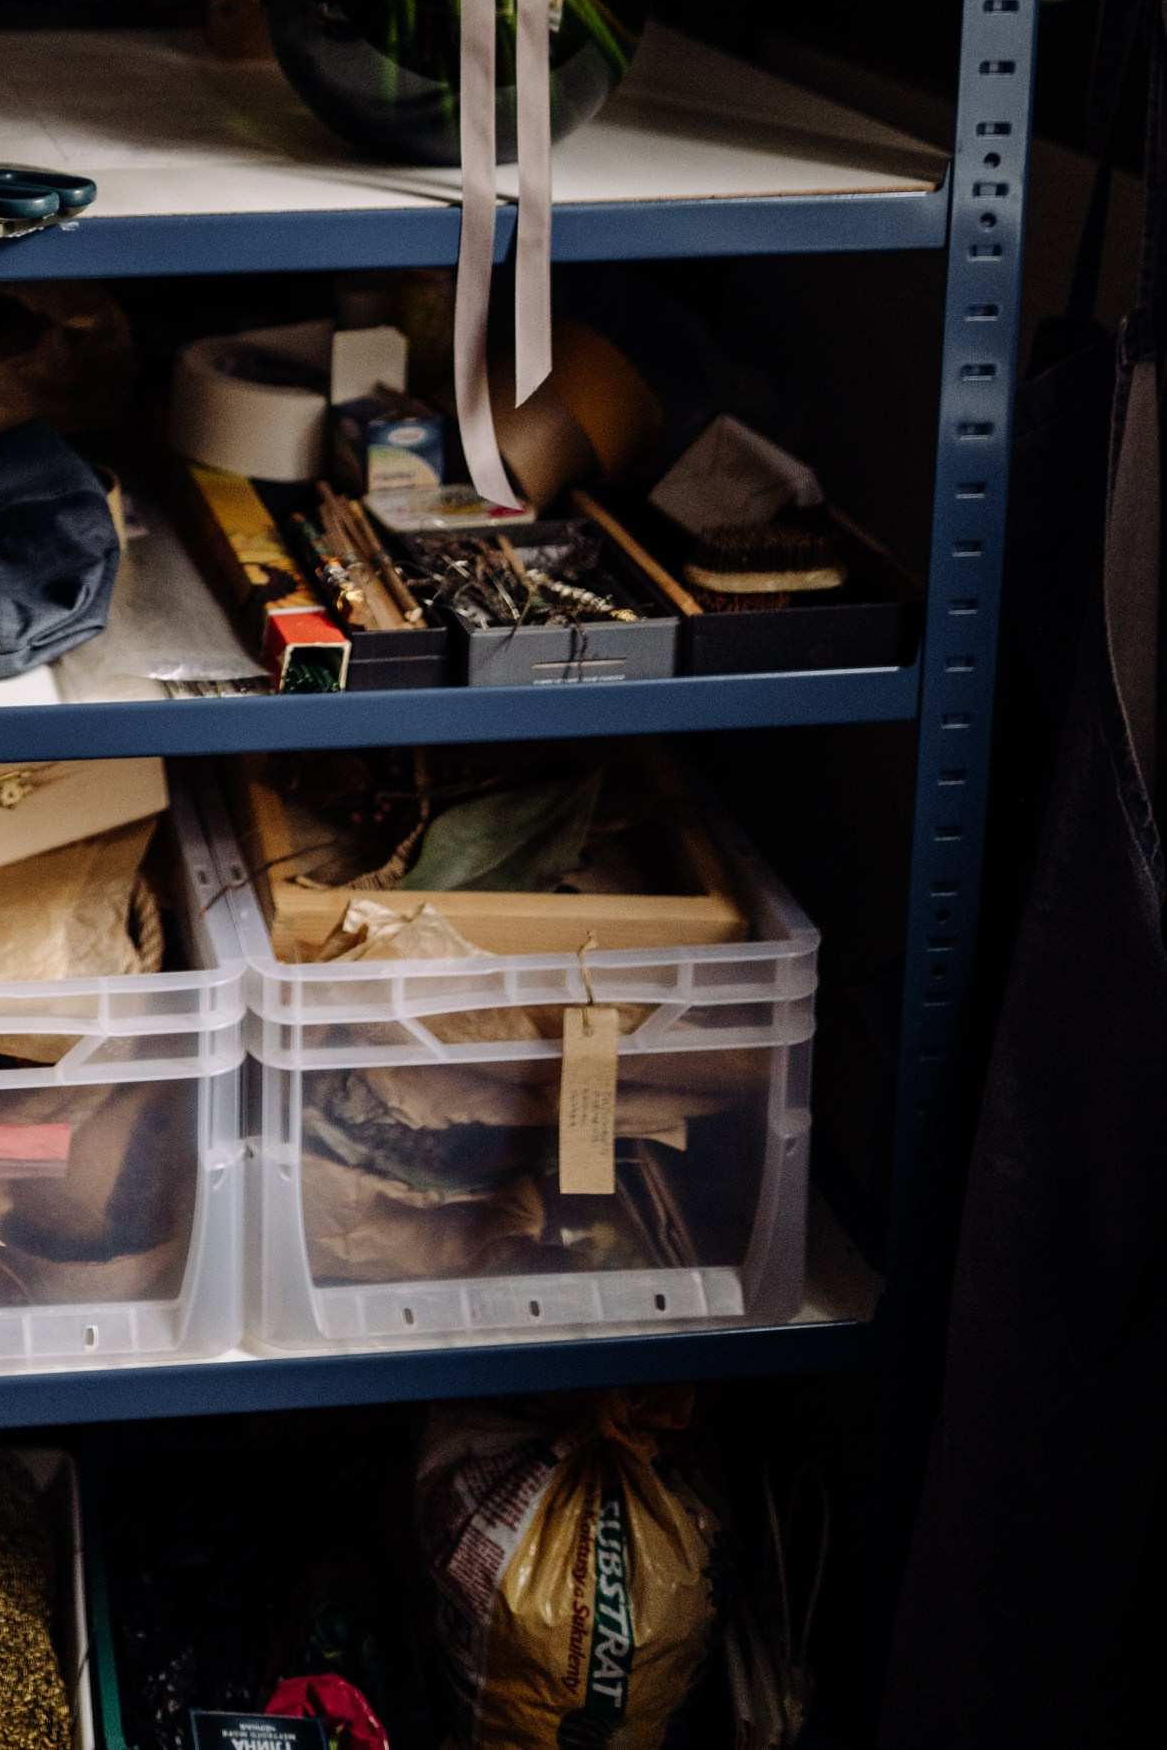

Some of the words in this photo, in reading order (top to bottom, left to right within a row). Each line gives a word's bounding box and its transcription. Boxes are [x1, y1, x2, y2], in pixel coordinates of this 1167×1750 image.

[572, 1509, 597, 1586] Kaktusy
[561, 1600, 590, 1695] Sukulenty
[591, 1498, 630, 1708] SUBSTRAT
